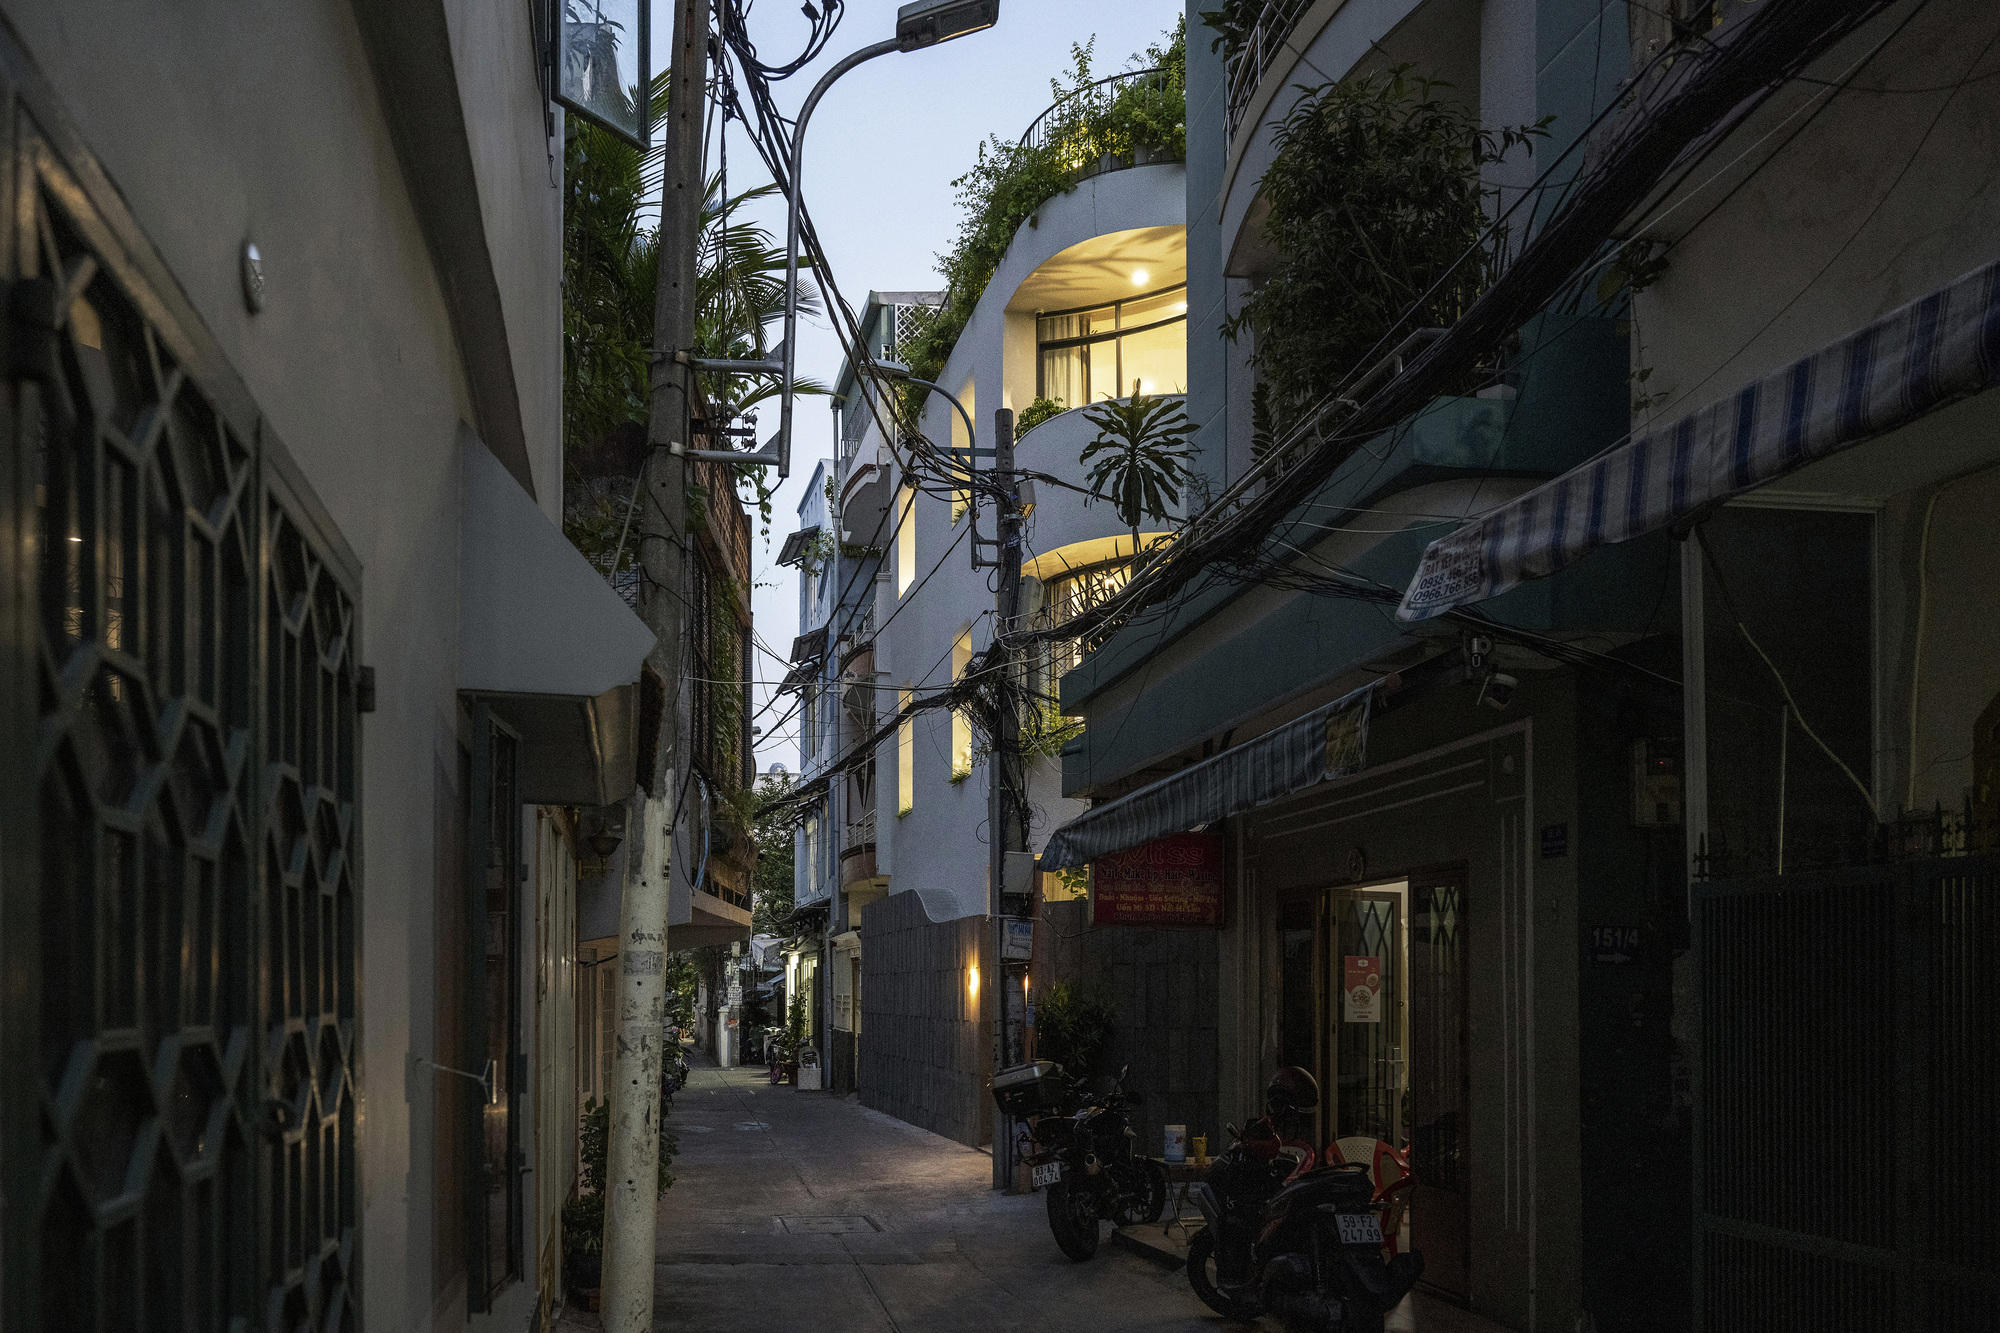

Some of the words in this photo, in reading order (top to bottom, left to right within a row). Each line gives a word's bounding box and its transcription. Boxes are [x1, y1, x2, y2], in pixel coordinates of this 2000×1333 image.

[1124, 867, 1145, 879] Make
[1164, 868, 1182, 880] Hair
[1593, 927, 1638, 949] 151/4
